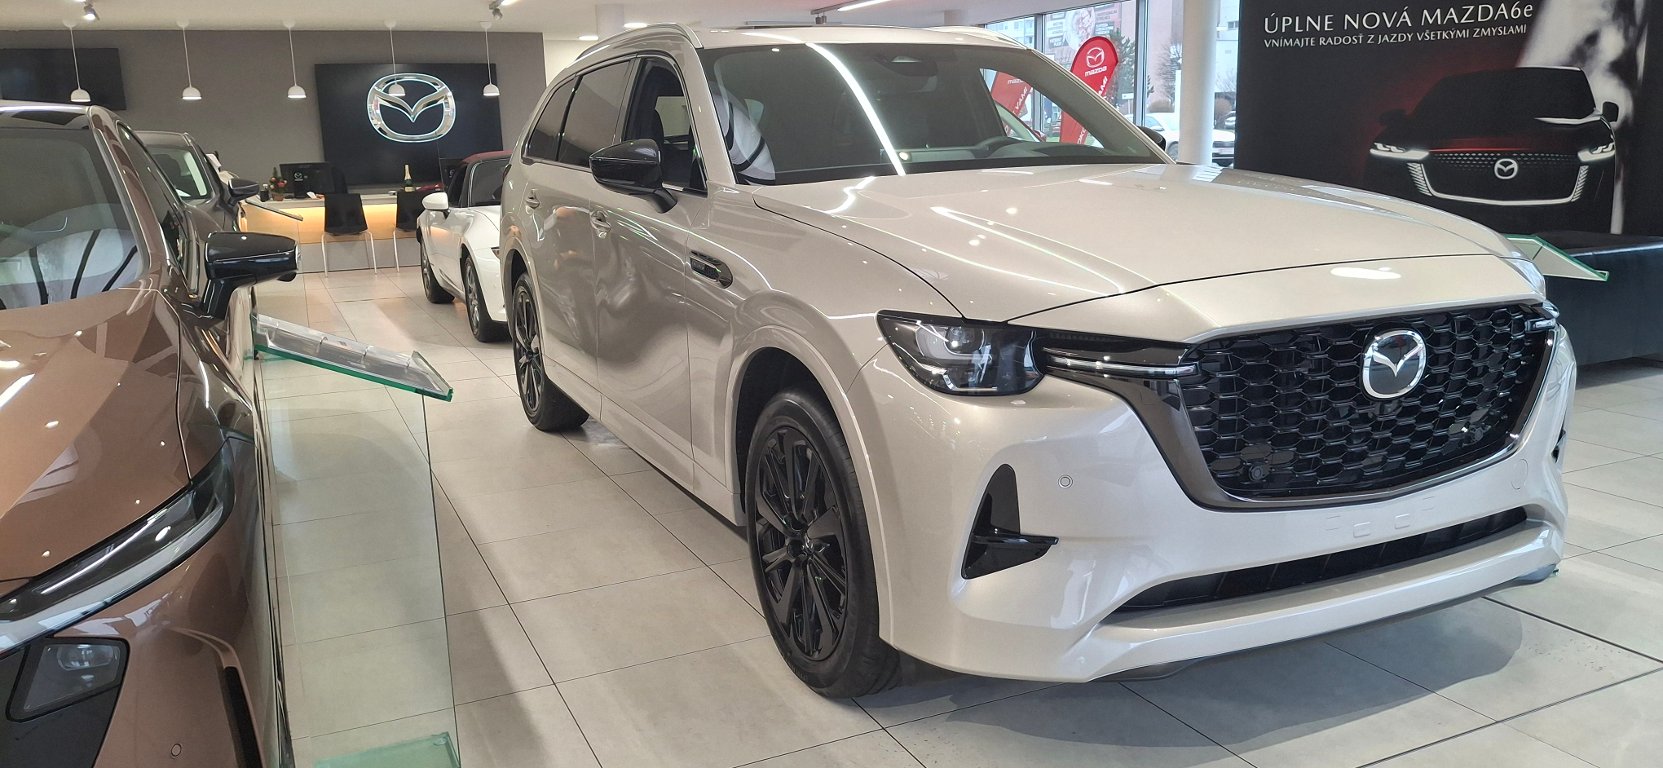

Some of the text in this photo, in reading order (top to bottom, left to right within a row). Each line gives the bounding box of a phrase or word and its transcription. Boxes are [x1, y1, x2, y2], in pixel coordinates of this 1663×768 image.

[1264, 1, 1534, 34] ÚPLNE NOVÁ MAZDA6e
[1264, 24, 1527, 48] VNÍMAJTE RADOSŤ Z JAZDY VŠETKÝMI ZMYSLAMI
